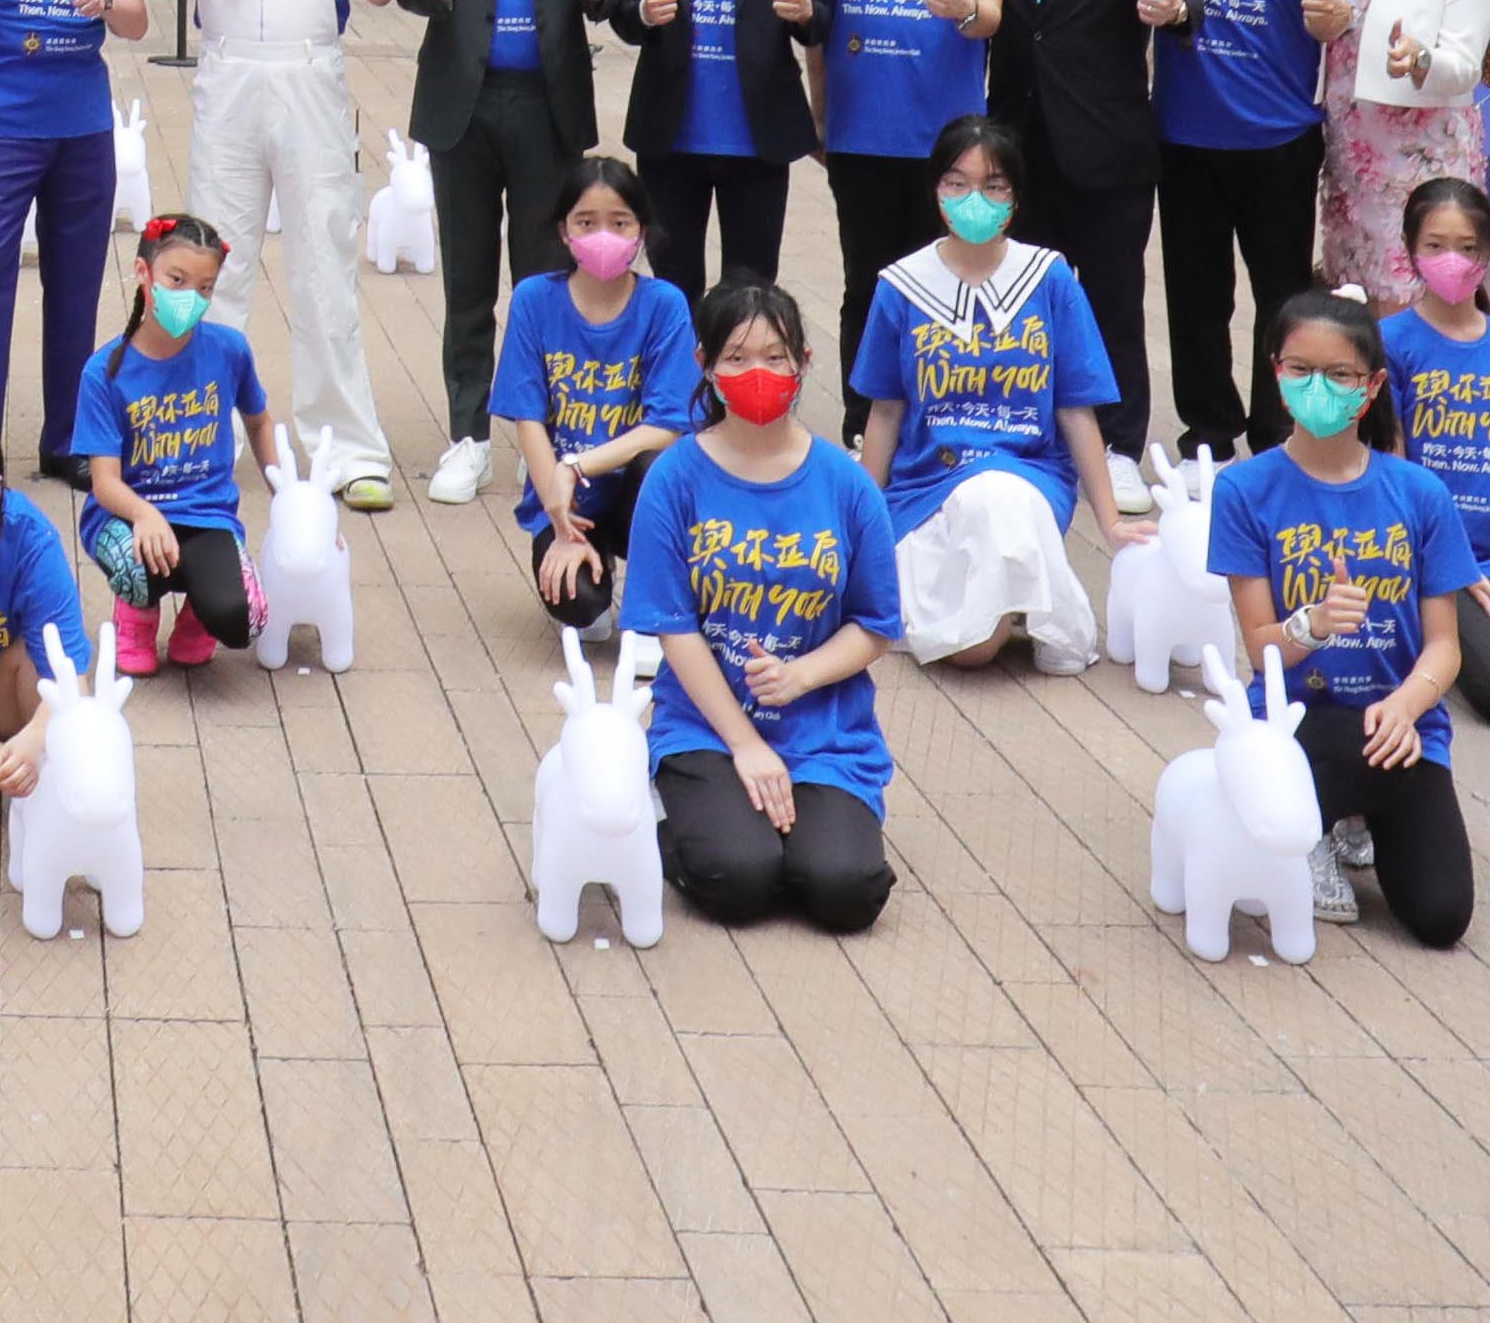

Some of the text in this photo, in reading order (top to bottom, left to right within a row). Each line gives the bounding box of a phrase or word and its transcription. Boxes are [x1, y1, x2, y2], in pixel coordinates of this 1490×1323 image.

[19, 5, 71, 17] Then. Now.
[865, 5, 890, 16] Now.
[1421, 457, 1450, 471] Then.
[1452, 460, 1479, 472] Now.
